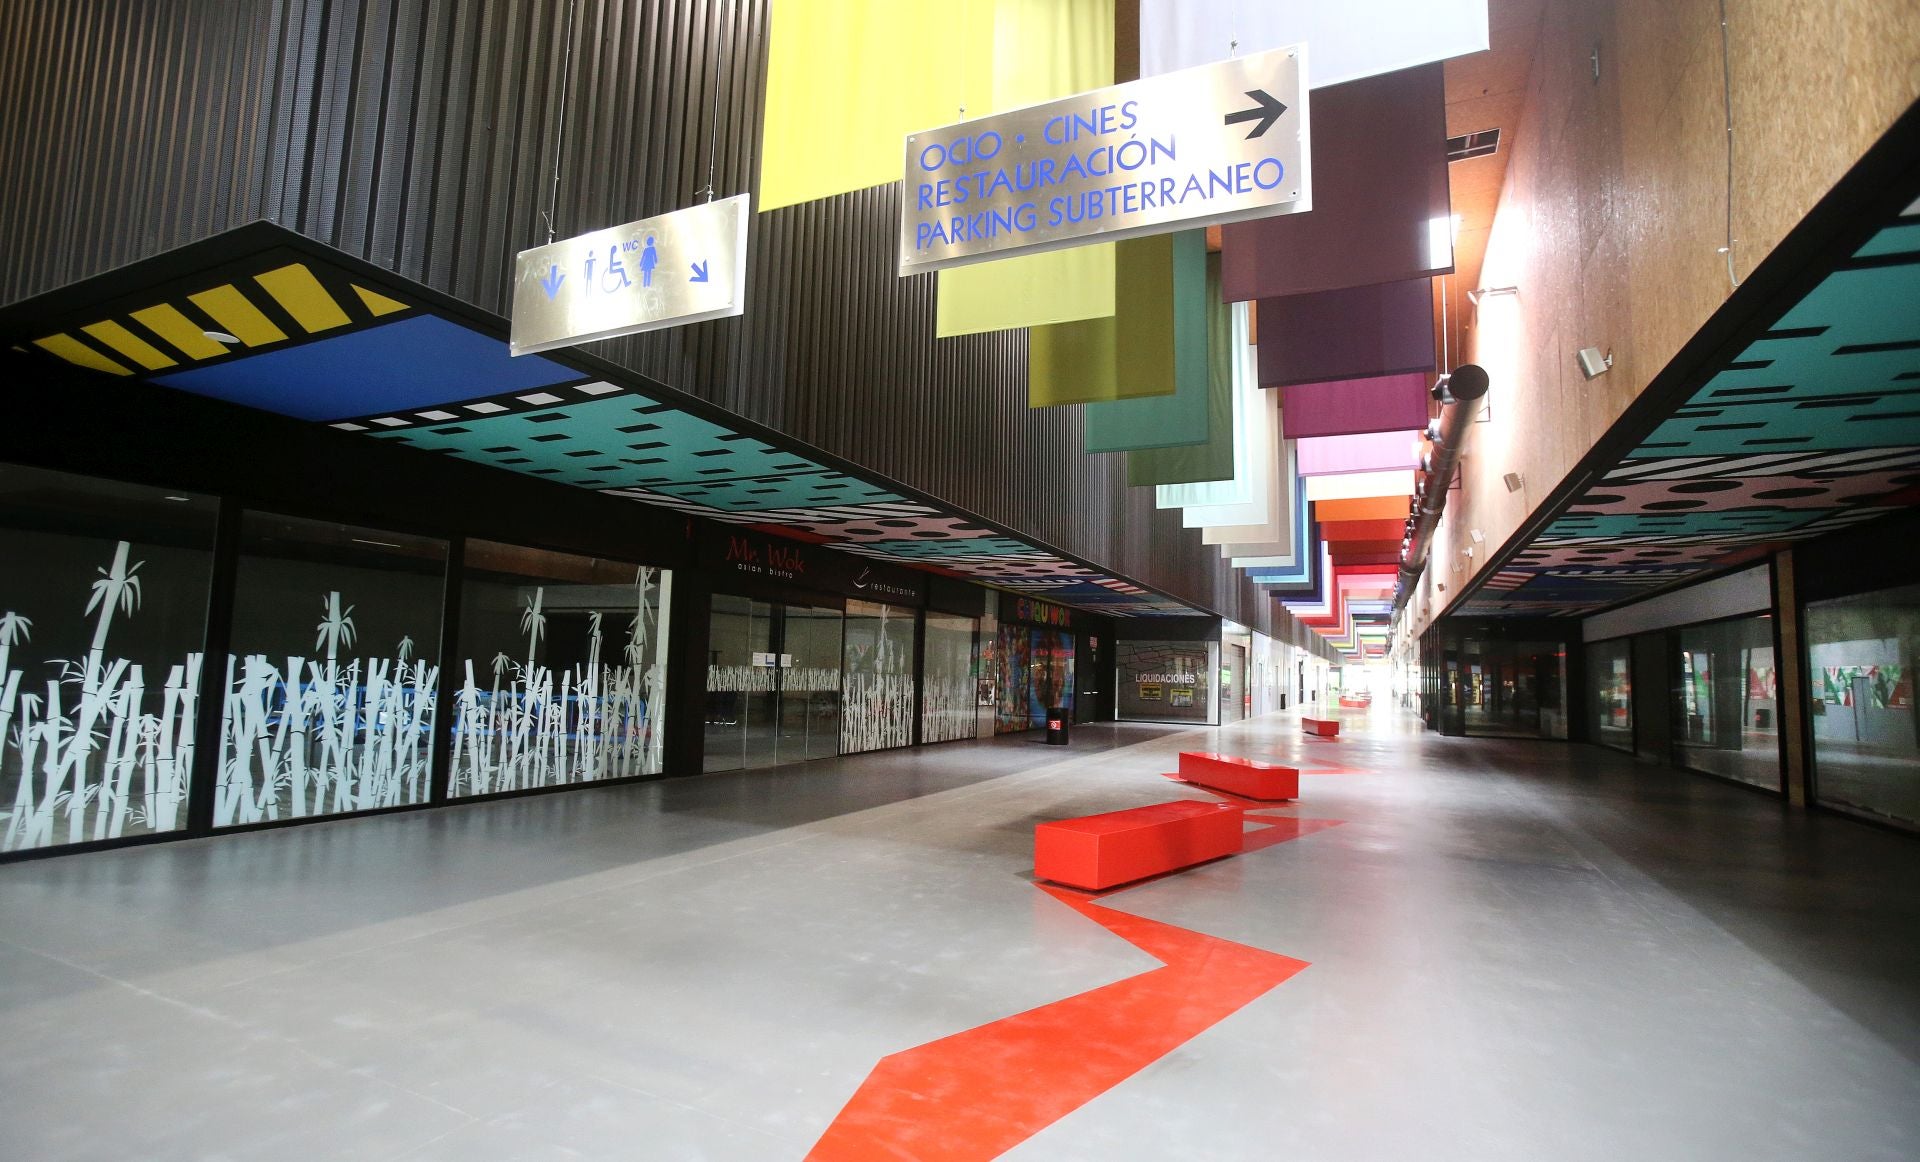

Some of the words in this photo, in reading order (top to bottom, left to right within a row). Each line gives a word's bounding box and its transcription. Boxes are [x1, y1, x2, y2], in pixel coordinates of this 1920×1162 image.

[920, 131, 1003, 171] OCIO
[1043, 100, 1139, 145] CINES
[917, 133, 1176, 212] RESTAURACIÓN
[916, 202, 1038, 250] PARKING
[1048, 157, 1284, 227] SUBTERRANEO
[622, 239, 639, 252] WC
[725, 535, 759, 562] Mr.
[768, 543, 806, 573] Wok
[737, 563, 763, 573] asian
[769, 568, 794, 579] bistro
[870, 582, 916, 597] restaurante
[1135, 673, 1195, 684] LIQUIDACIONES
